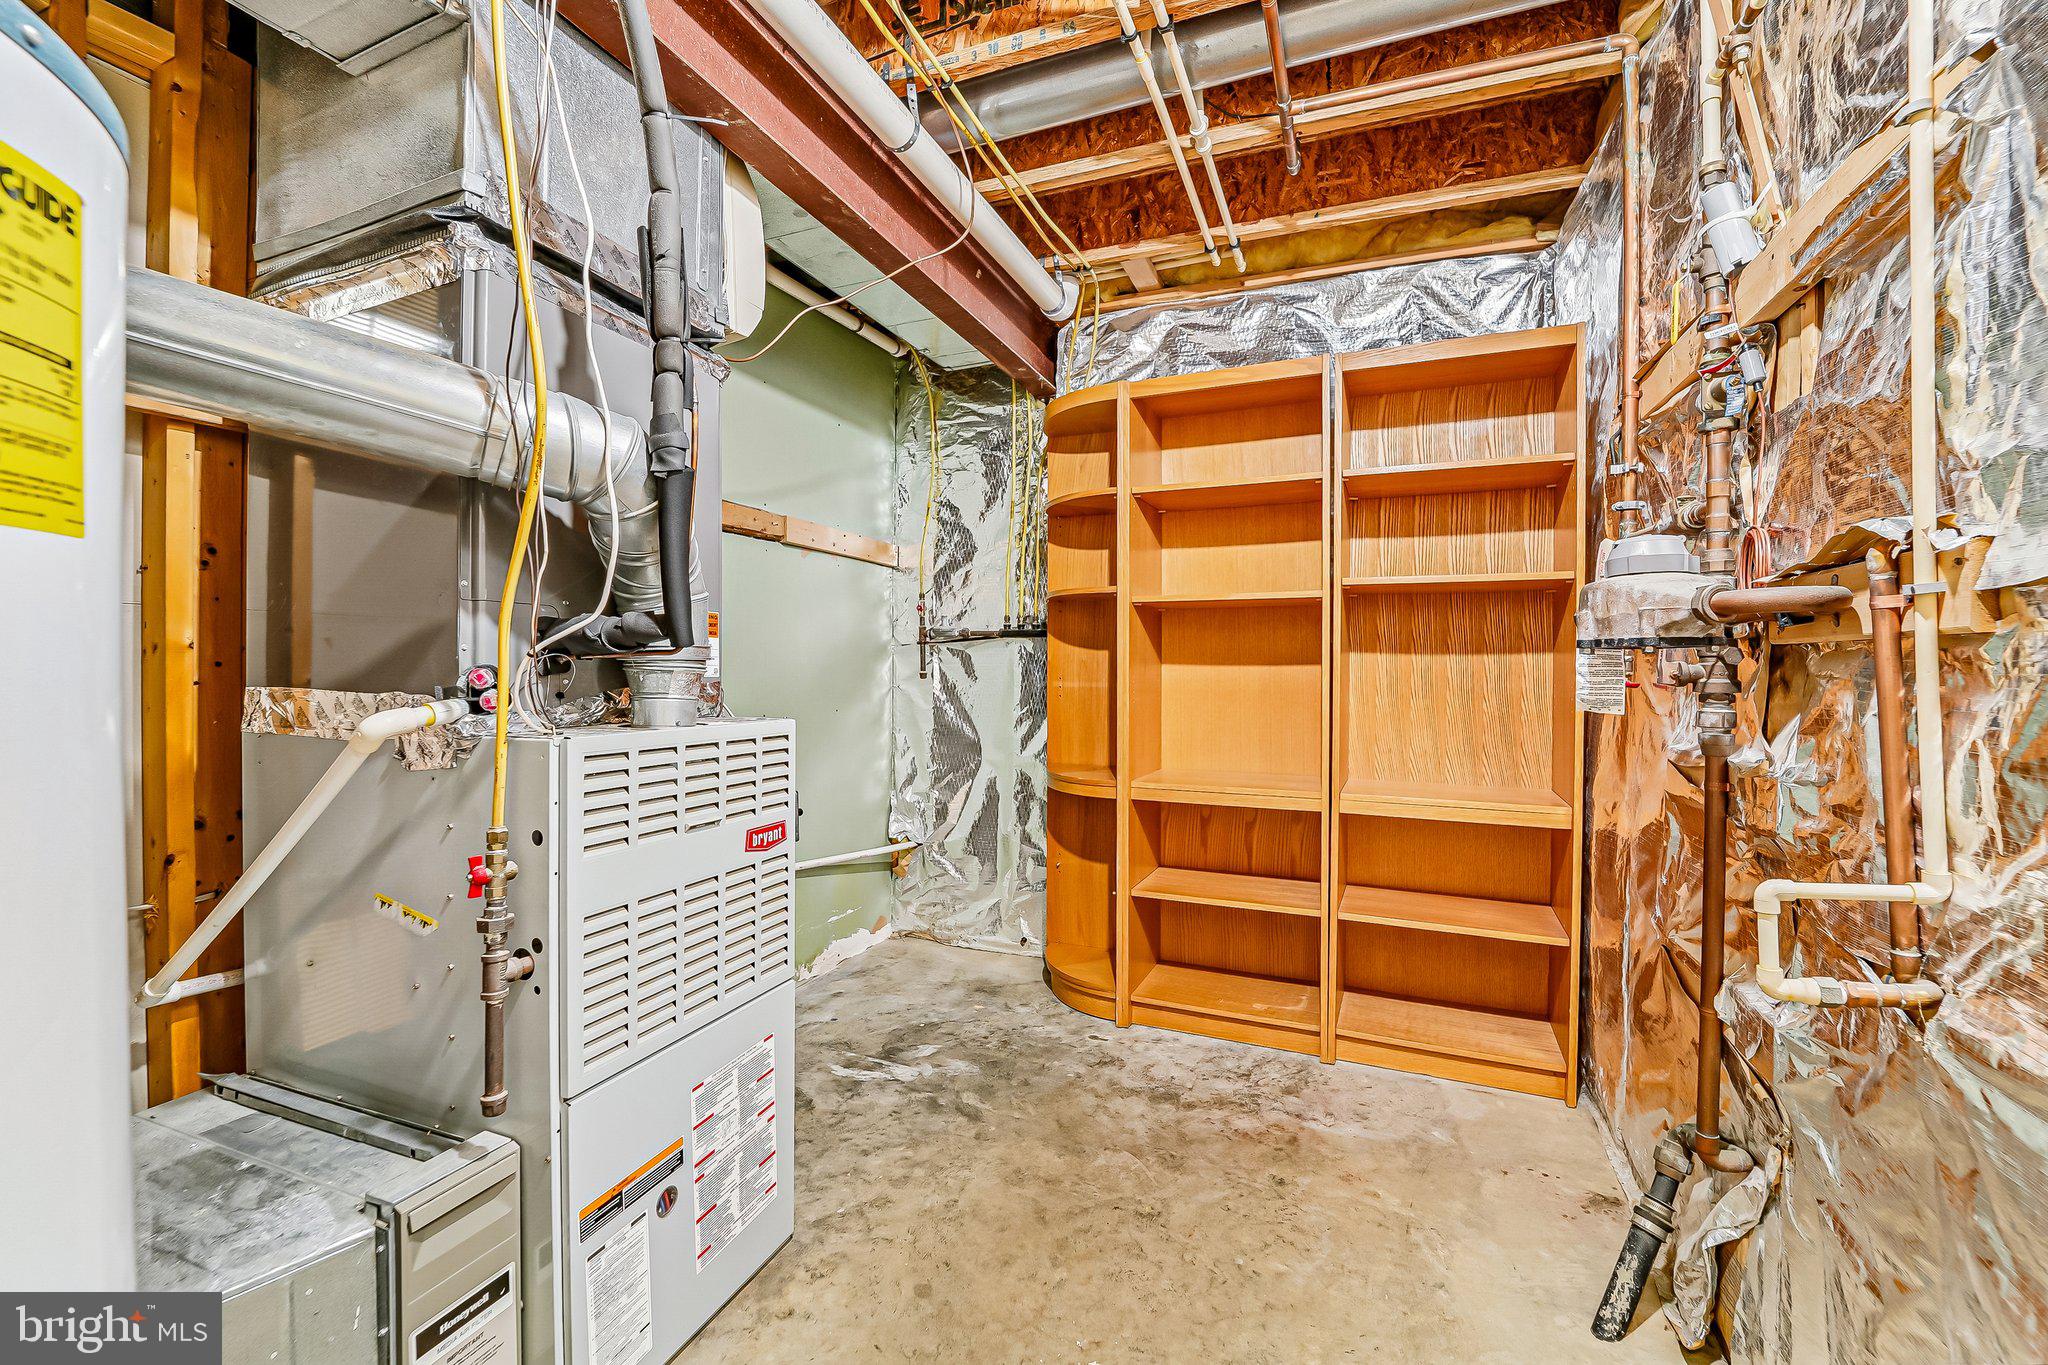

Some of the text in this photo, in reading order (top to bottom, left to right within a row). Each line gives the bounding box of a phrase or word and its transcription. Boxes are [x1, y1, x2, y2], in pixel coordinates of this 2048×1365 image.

[0, 166, 76, 237] GUIDE
[752, 827, 782, 847] bryant
[439, 1292, 490, 1335] Honeywell
